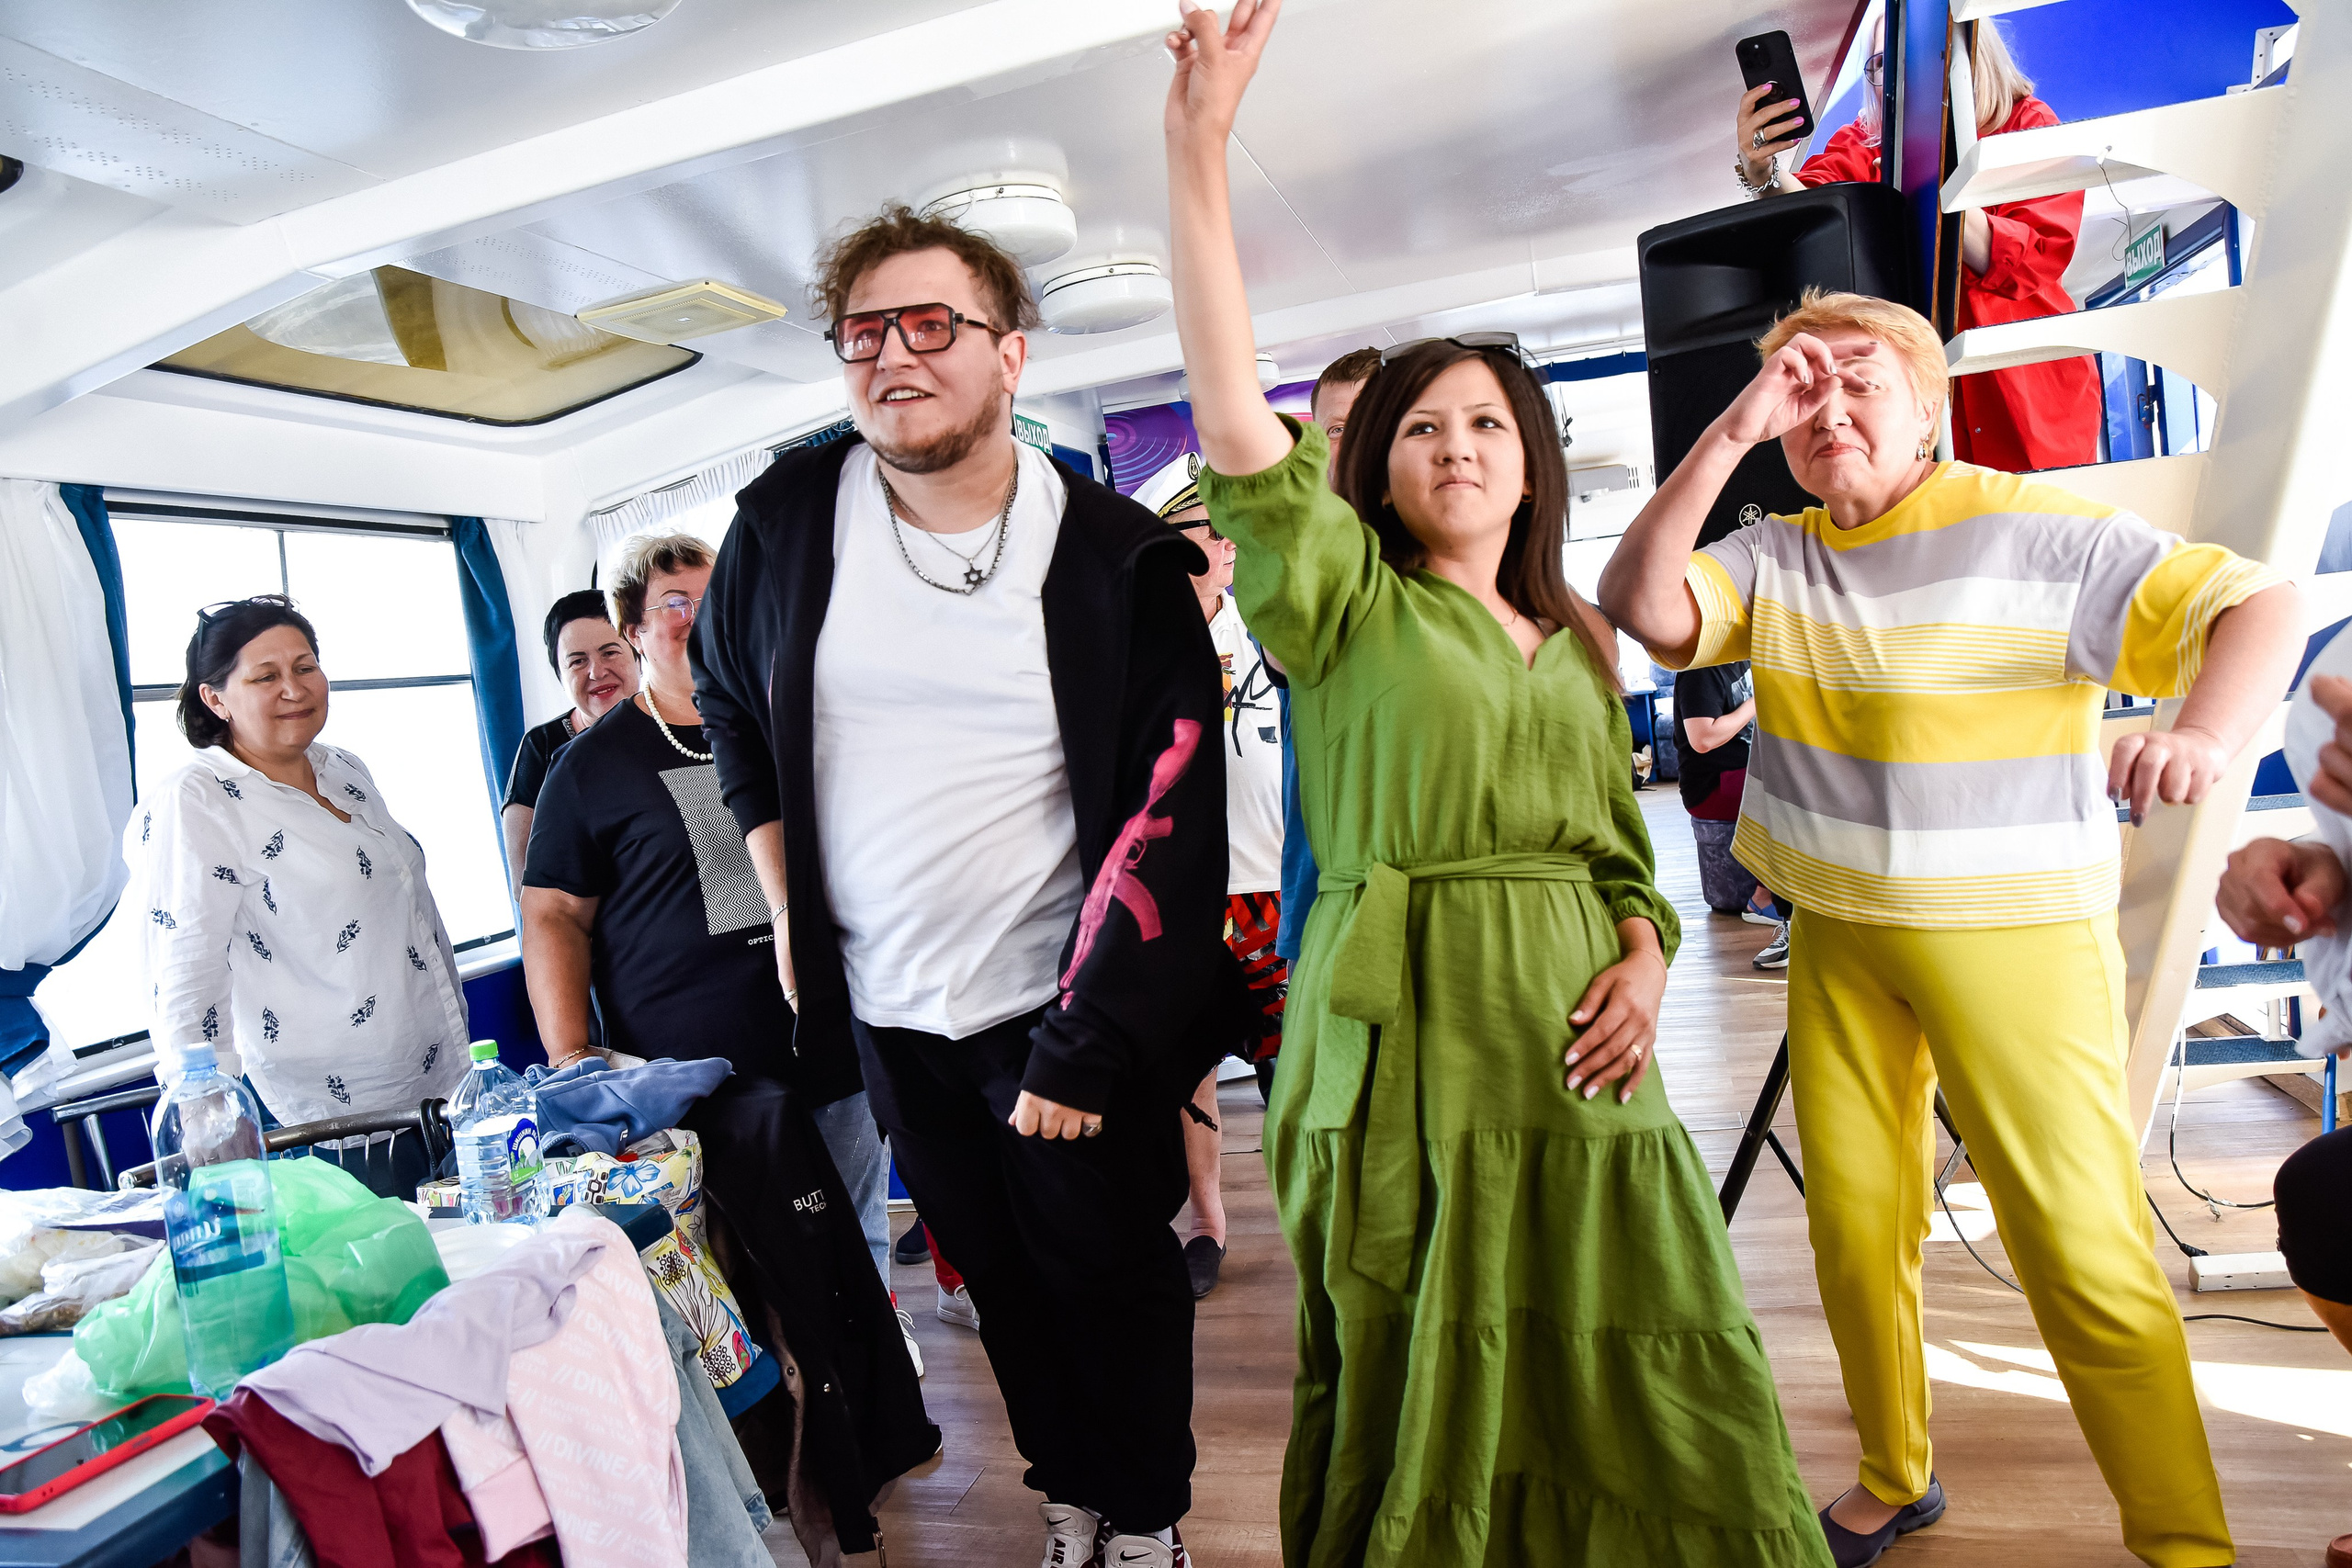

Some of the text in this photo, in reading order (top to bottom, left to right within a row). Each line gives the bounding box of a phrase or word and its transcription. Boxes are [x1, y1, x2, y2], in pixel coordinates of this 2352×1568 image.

[2125, 231, 2162, 277] ВЫХОД
[1016, 419, 1051, 454] ВЫХОД
[1050, 1537, 1066, 1565] AIR
